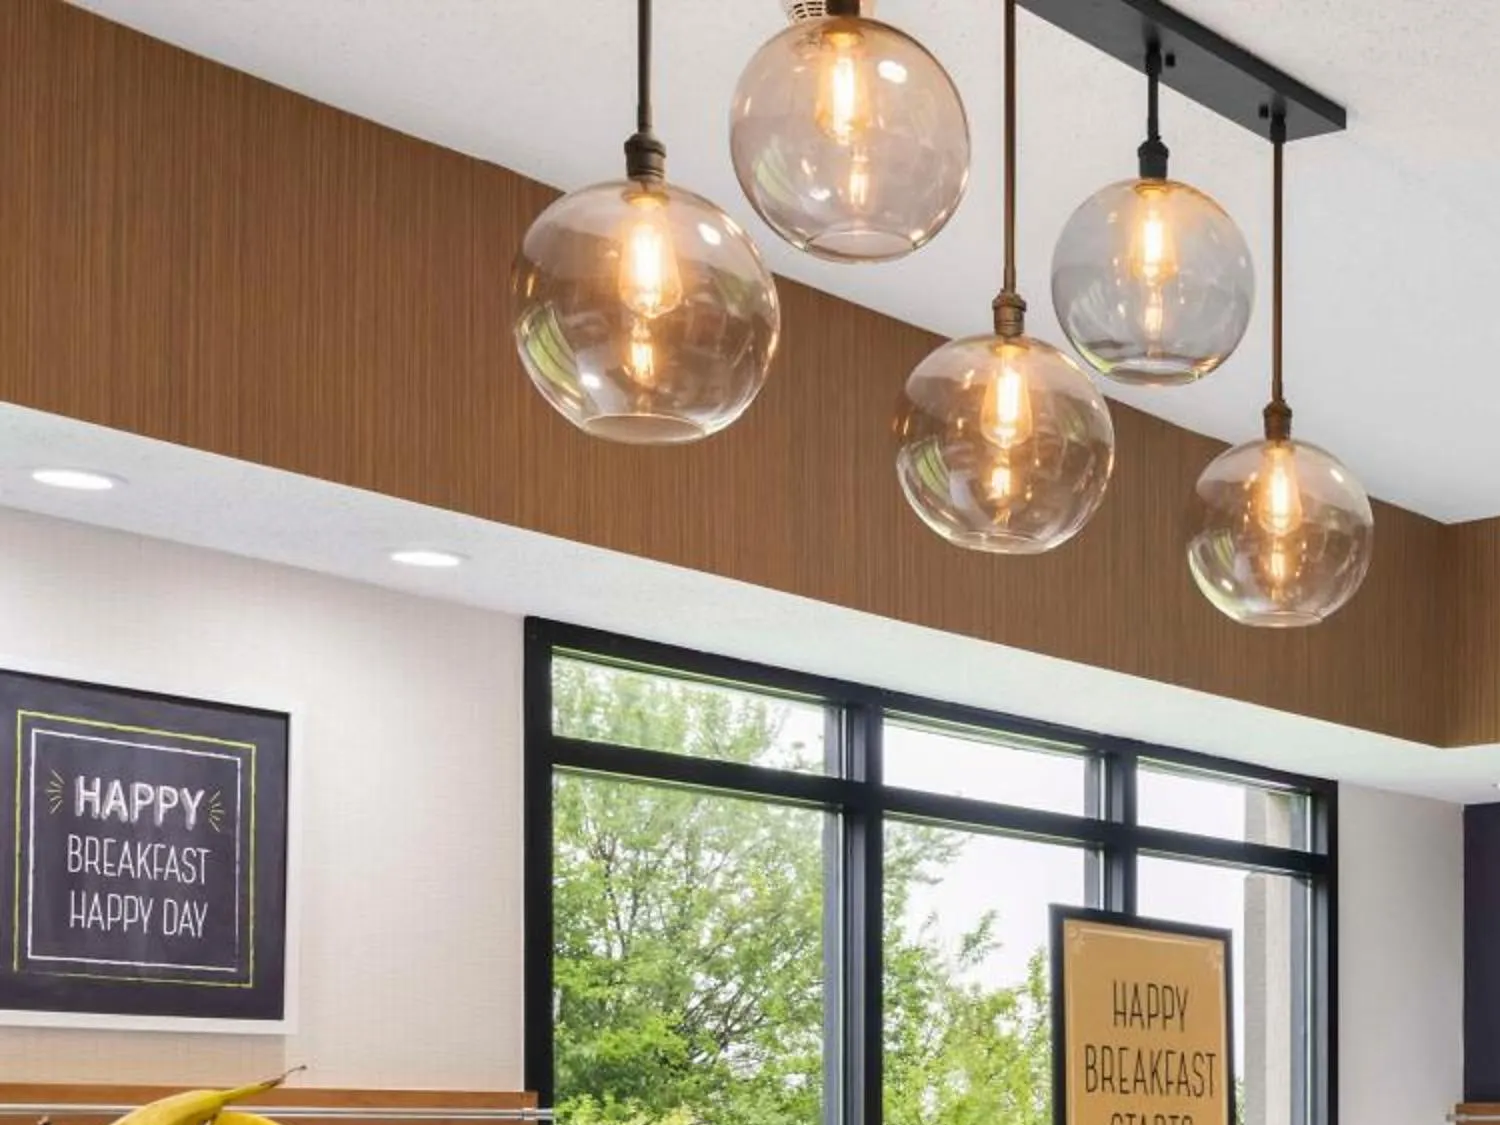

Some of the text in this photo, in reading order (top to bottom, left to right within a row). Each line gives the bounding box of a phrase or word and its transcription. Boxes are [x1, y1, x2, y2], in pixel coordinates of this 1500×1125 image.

[74, 775, 205, 831] HAPPY
[67, 834, 211, 885] BREAKFAST
[69, 890, 208, 938] HAPPY DAY
[1113, 980, 1189, 1032] HAPPY
[1084, 1044, 1217, 1098] BREAKFAST
